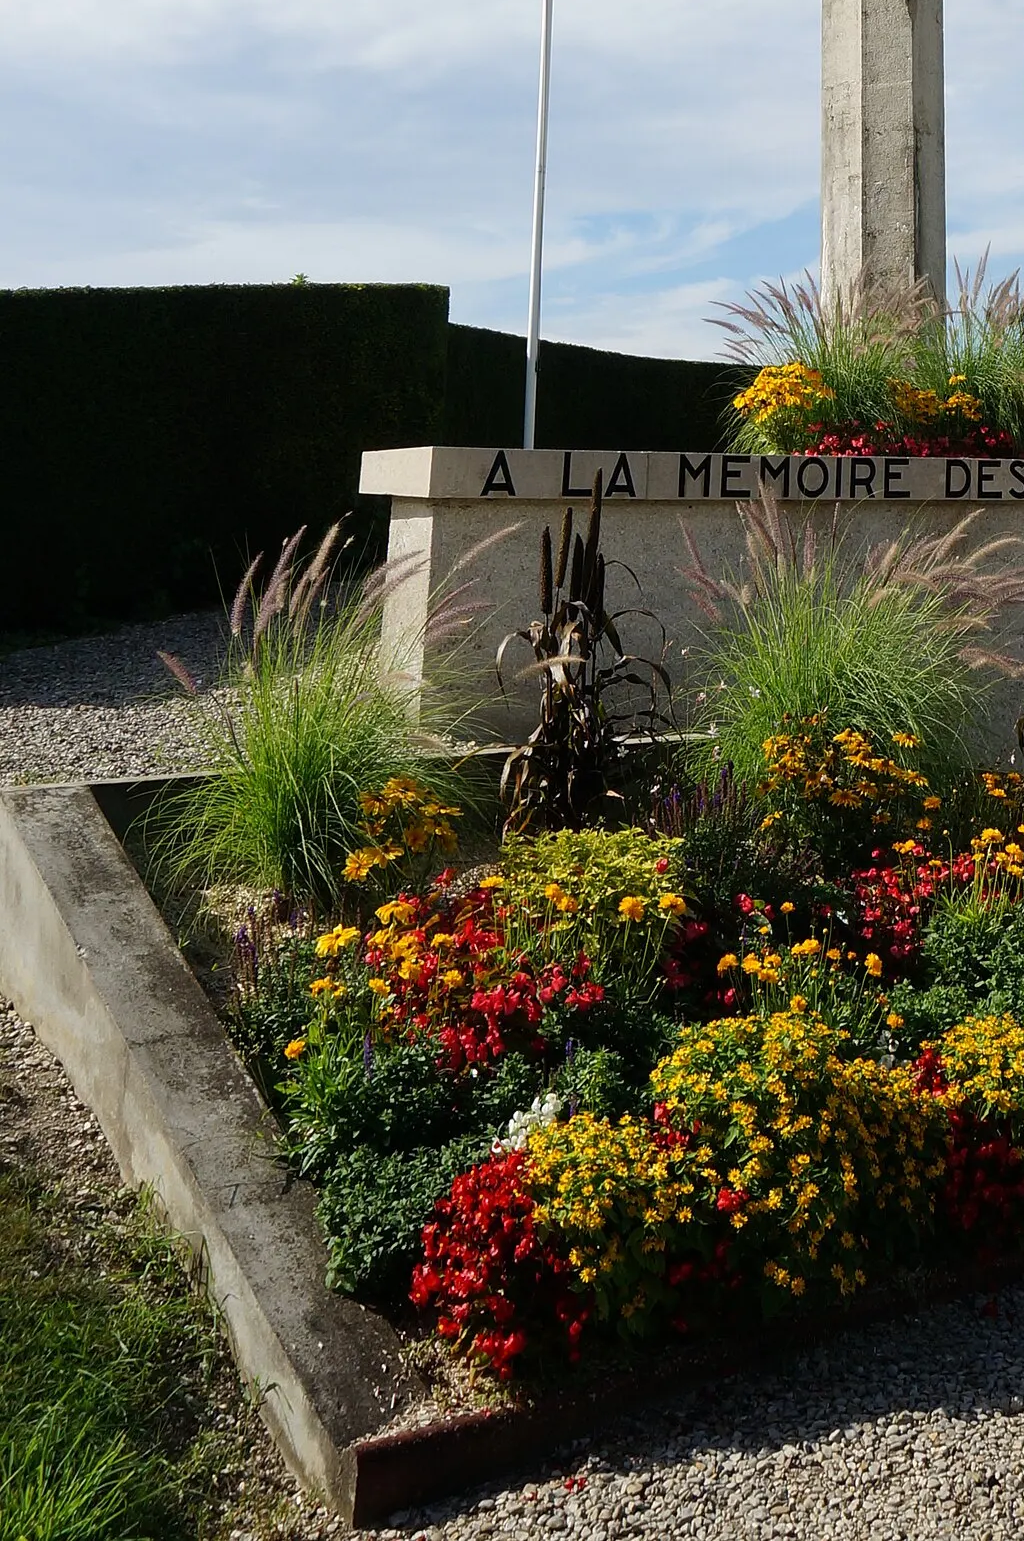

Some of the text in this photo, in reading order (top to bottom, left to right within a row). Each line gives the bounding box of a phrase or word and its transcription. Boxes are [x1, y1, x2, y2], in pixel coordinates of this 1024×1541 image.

[480, 450, 516, 497] A
[561, 452, 636, 498] LA
[678, 453, 911, 499] MEMOIRE
